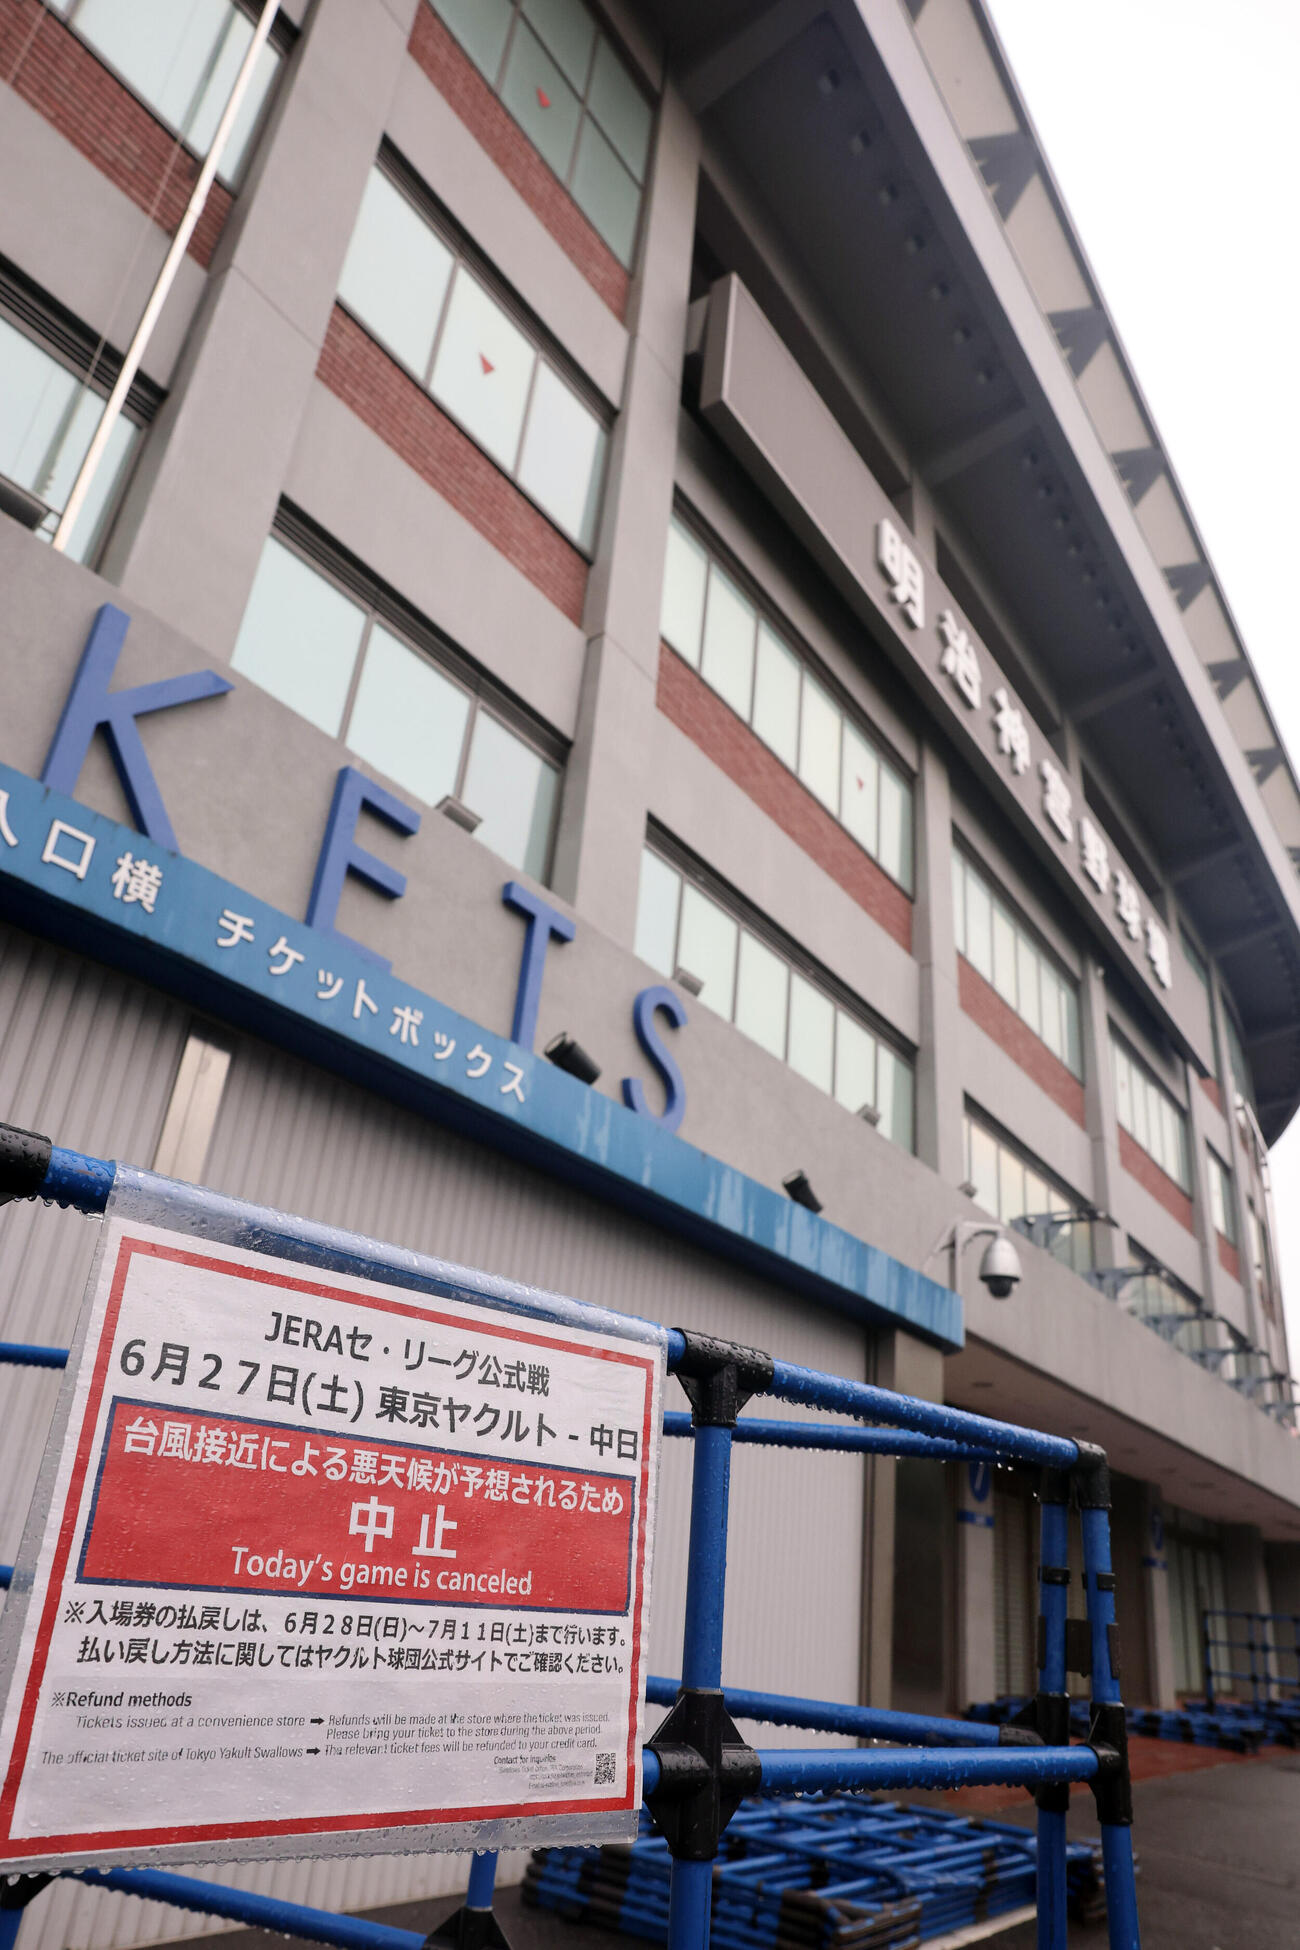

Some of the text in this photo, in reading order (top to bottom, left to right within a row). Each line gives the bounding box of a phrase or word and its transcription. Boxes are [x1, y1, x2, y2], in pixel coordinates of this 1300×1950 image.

[216, 908, 529, 1105] チケットボックス
[264, 1311, 550, 1397] JERAセ・リーグ公式戦
[589, 1423, 639, 1460] 中日
[123, 1415, 625, 1516] 台風接近による悪天候が予想されるため
[231, 1546, 533, 1596] Today's game is canceled
[76, 1635, 625, 1675] 払い戻し方法に関してはヤクルト球団公式サイトでご確認ください。
[127, 1691, 193, 1708] methods
[76, 1714, 306, 1729] Tickets issued at a convenience store
[326, 1728, 360, 1740] Please
[362, 1727, 390, 1741] bring
[392, 1728, 416, 1741] your
[418, 1726, 444, 1738] ticket
[446, 1727, 456, 1738] to
[458, 1726, 473, 1737] the
[475, 1727, 499, 1738] store
[500, 1725, 530, 1738] during
[531, 1725, 546, 1736] the
[547, 1725, 574, 1736] above
[328, 1714, 371, 1727] Refunds
[373, 1713, 392, 1726] will
[394, 1713, 407, 1726] be
[409, 1714, 436, 1726] made
[438, 1714, 448, 1725] at
[450, 1713, 465, 1725] the
[467, 1714, 492, 1725] store
[493, 1713, 522, 1724] where
[523, 1712, 538, 1724] the
[538, 1712, 562, 1724] ticket
[564, 1713, 581, 1723] was
[41, 1745, 304, 1765] The official ticket site of Tokyo Yakult Swallows
[325, 1737, 598, 1756] The relevant ticket fees will be refunded to your credit card.
